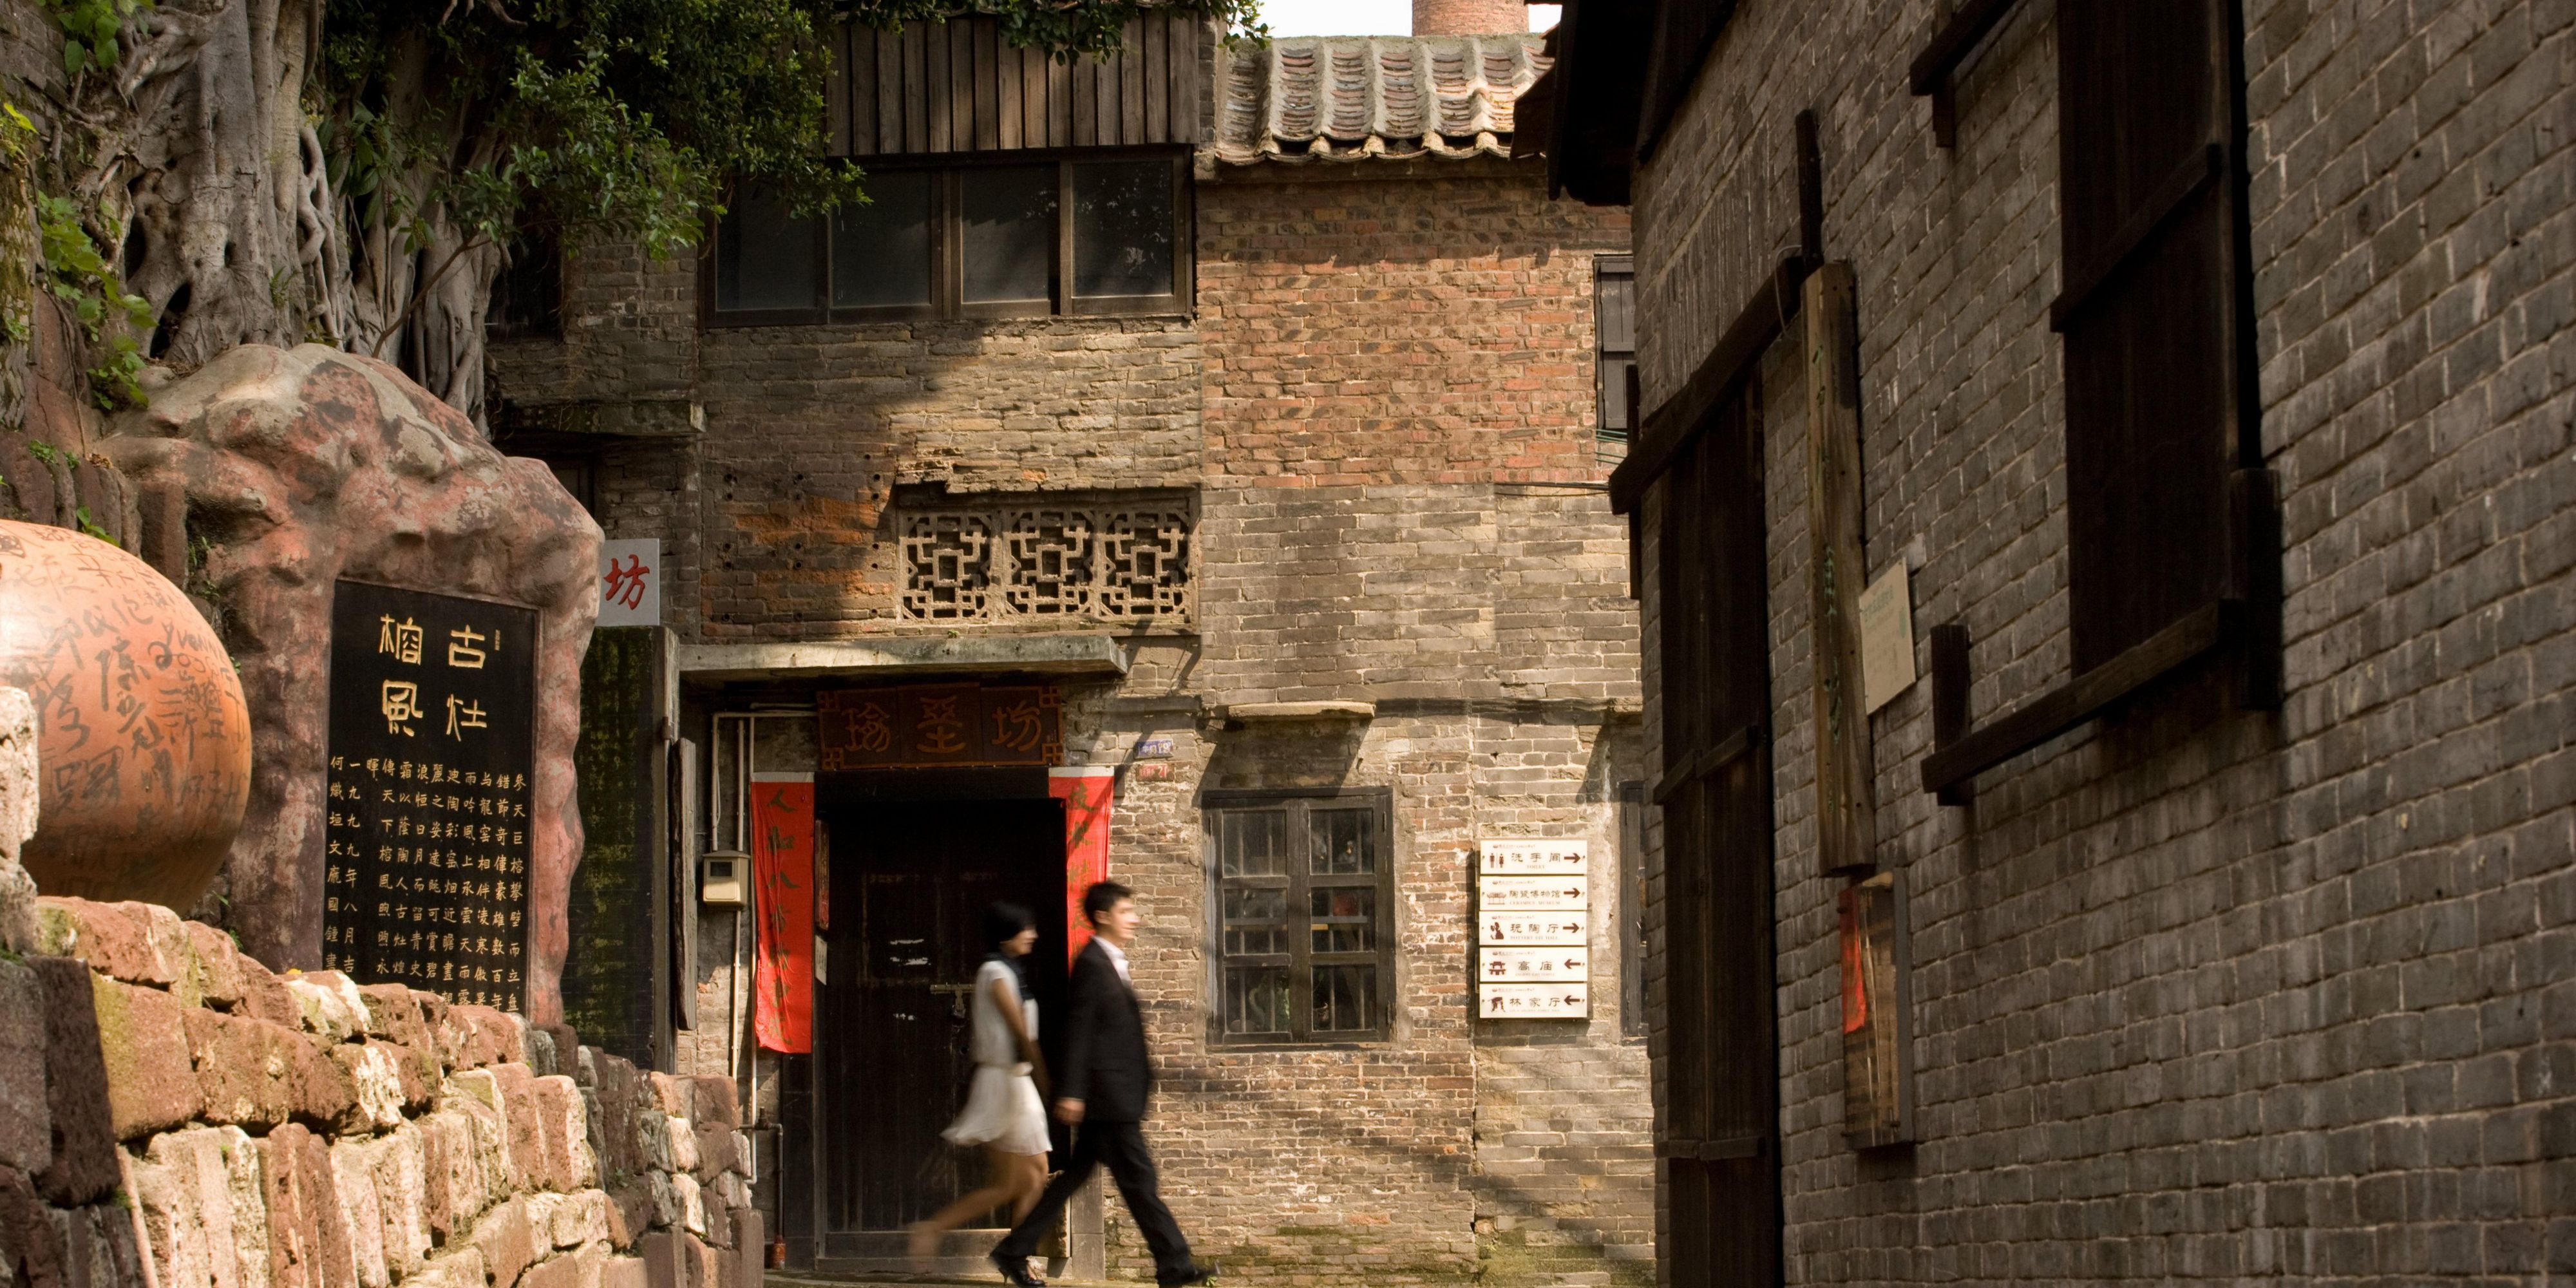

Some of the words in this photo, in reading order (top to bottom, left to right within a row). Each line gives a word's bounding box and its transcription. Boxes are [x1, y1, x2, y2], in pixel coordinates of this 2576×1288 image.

[603, 554, 649, 610] 坊
[1511, 853, 1560, 863] 洗手间
[1509, 890, 1560, 899] 陶瓷博物馆
[1510, 923, 1558, 933] 玩陶厅
[1518, 961, 1552, 971] 高庙
[1510, 998, 1561, 1007] 林家厅
